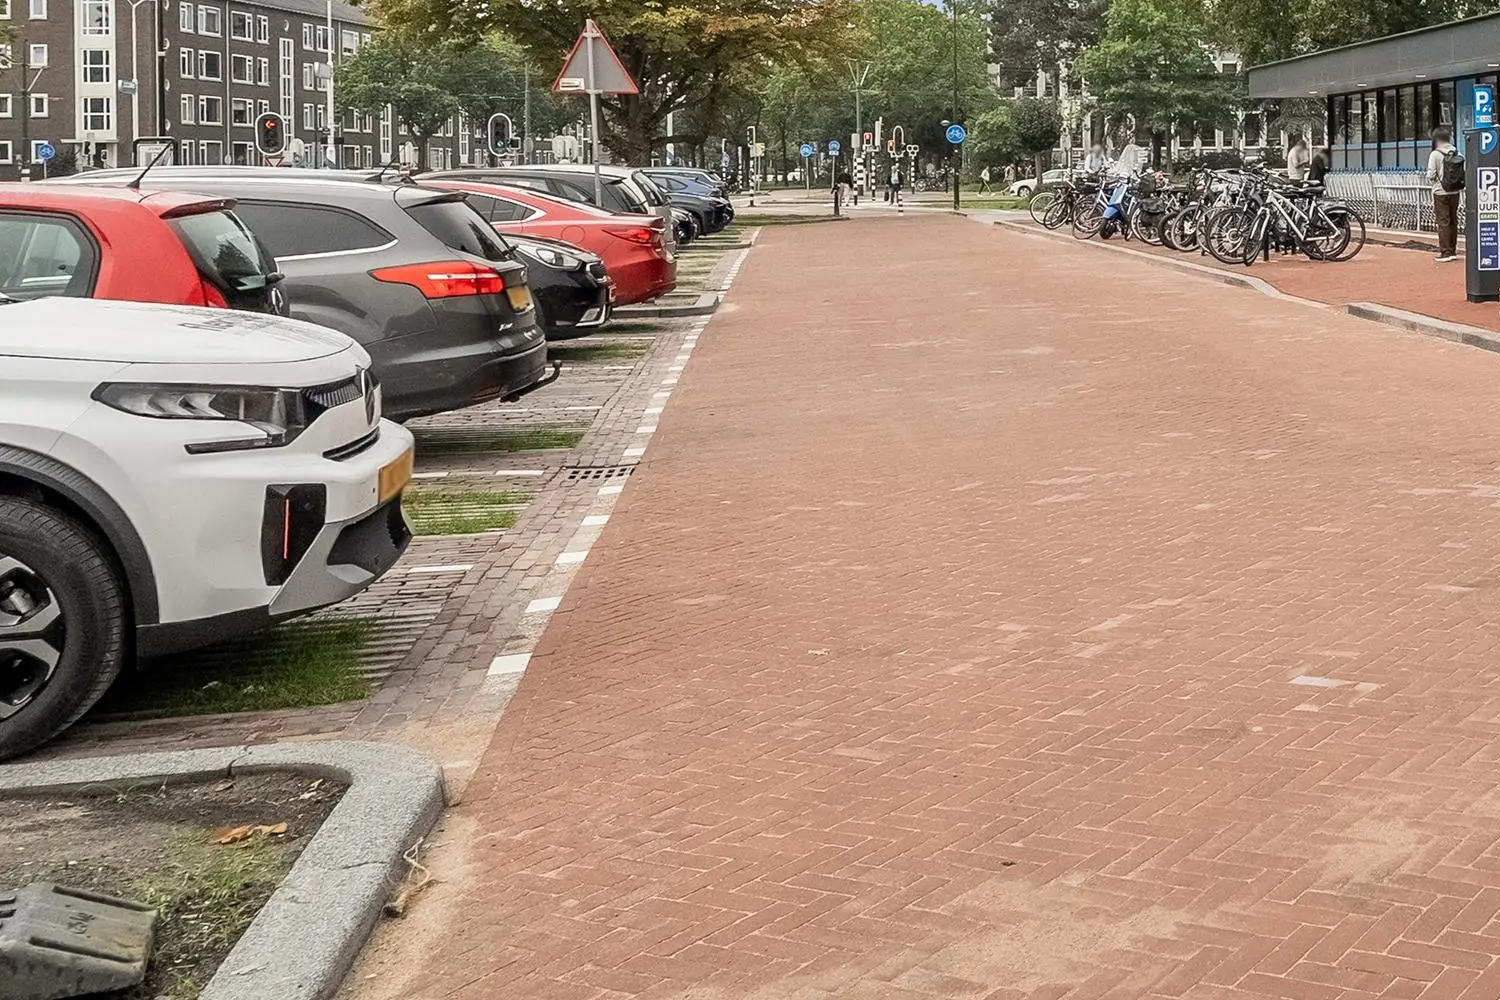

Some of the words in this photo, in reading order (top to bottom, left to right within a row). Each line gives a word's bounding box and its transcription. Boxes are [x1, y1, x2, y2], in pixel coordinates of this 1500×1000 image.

[1475, 91, 1489, 111] P
[1481, 132, 1493, 150] P
[1481, 170, 1496, 189] P
[1491, 188, 1497, 202] 1
[1479, 203, 1499, 211] UUR
